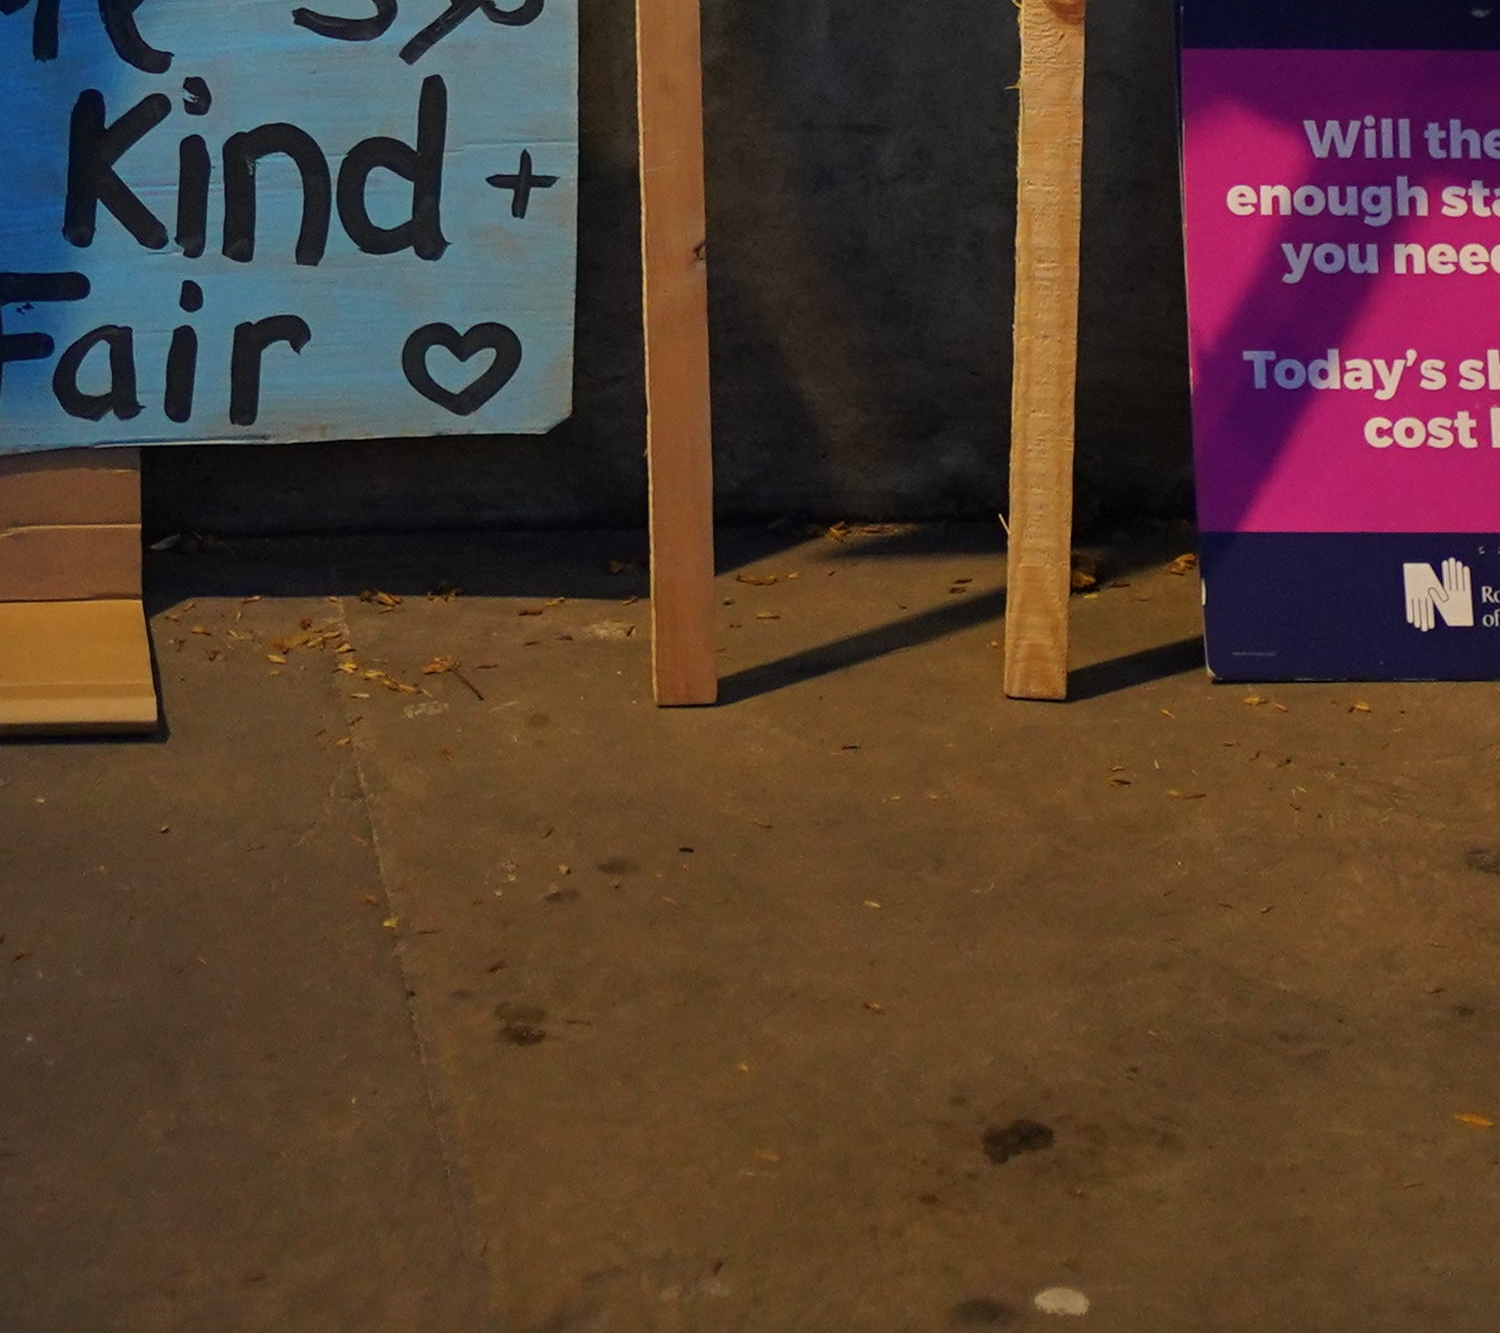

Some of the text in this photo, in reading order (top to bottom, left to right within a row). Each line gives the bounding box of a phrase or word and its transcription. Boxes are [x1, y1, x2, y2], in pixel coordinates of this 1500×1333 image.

[1303, 117, 1411, 160] Will
[62, 75, 449, 266] Kind
[1226, 176, 1428, 226] enough
[1281, 241, 1379, 282] you
[1243, 348, 1446, 400] Today's
[1364, 412, 1477, 449] cost
[1482, 609, 1500, 628] of
